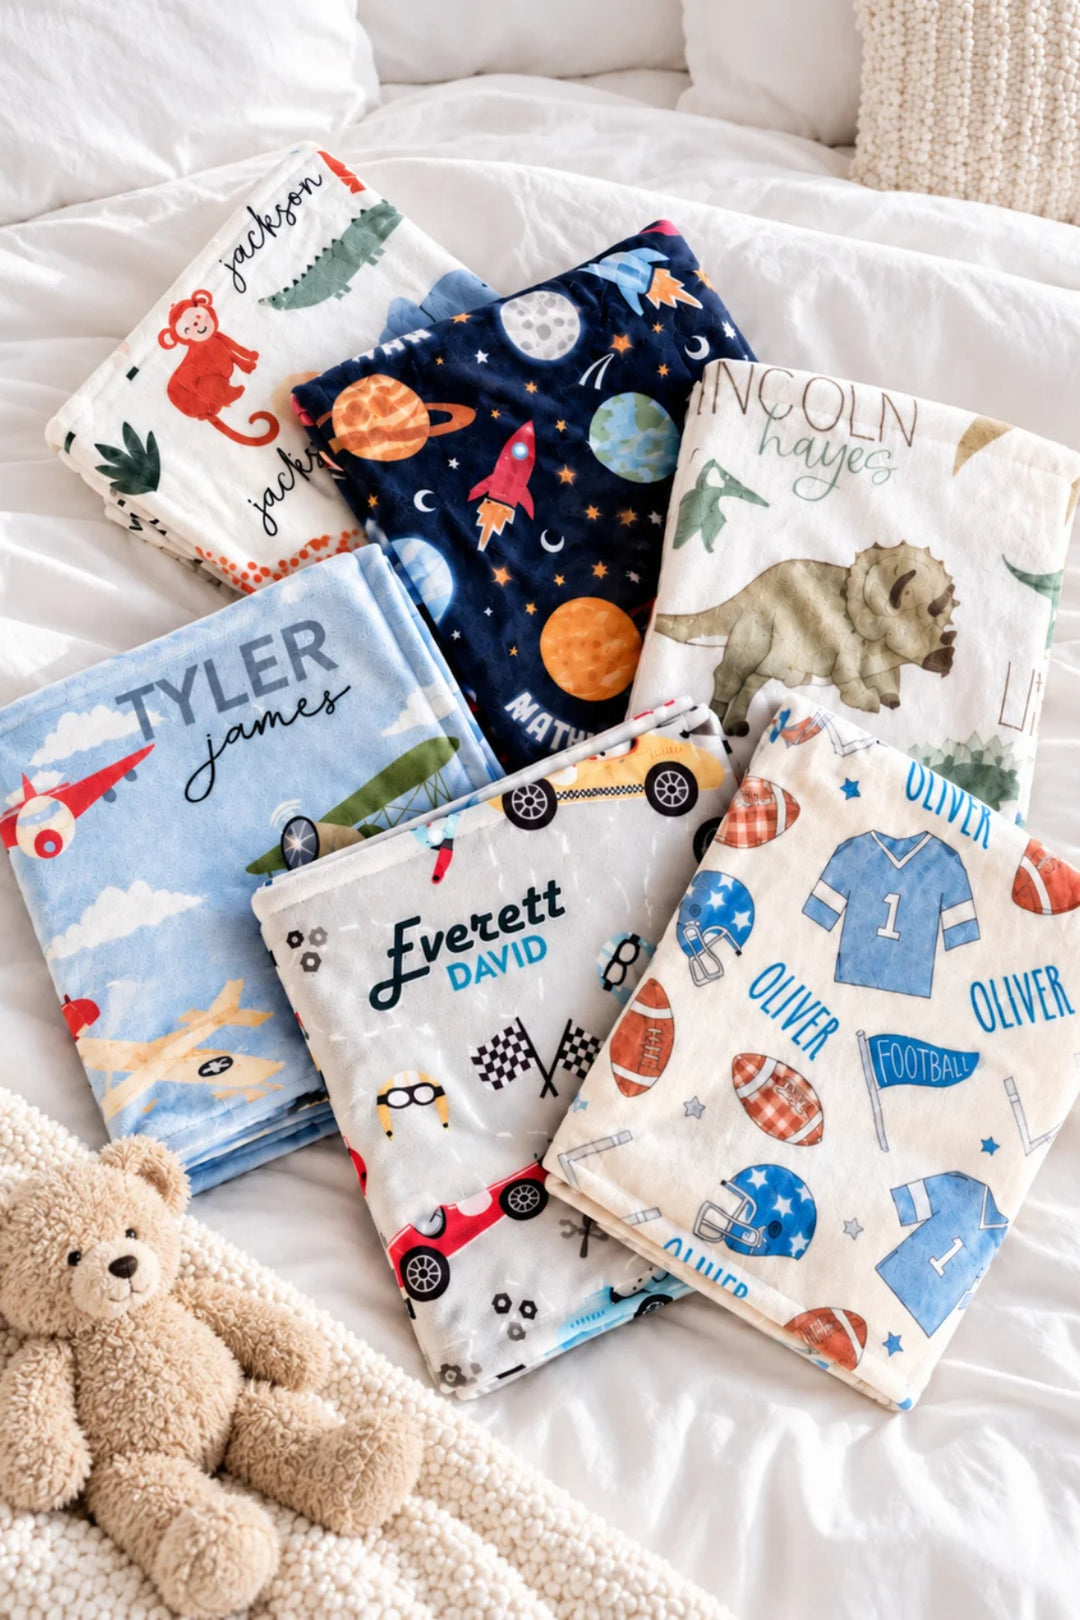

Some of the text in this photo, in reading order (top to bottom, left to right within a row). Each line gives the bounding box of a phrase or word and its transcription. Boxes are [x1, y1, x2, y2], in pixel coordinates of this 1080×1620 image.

[218, 173, 322, 294] jackson
[758, 402, 897, 502] hayes
[115, 619, 340, 742] TYLER
[504, 691, 596, 750] MATH
[184, 685, 351, 803] james
[906, 761, 991, 849] OLIVER
[369, 880, 566, 1011] Everett
[876, 892, 901, 941] 1
[446, 934, 548, 991] DAVID
[969, 965, 1075, 1033] OLIVER
[748, 962, 840, 1061] OLIVER
[876, 1039, 970, 1083] FOOTBALL
[928, 1237, 964, 1277] 1
